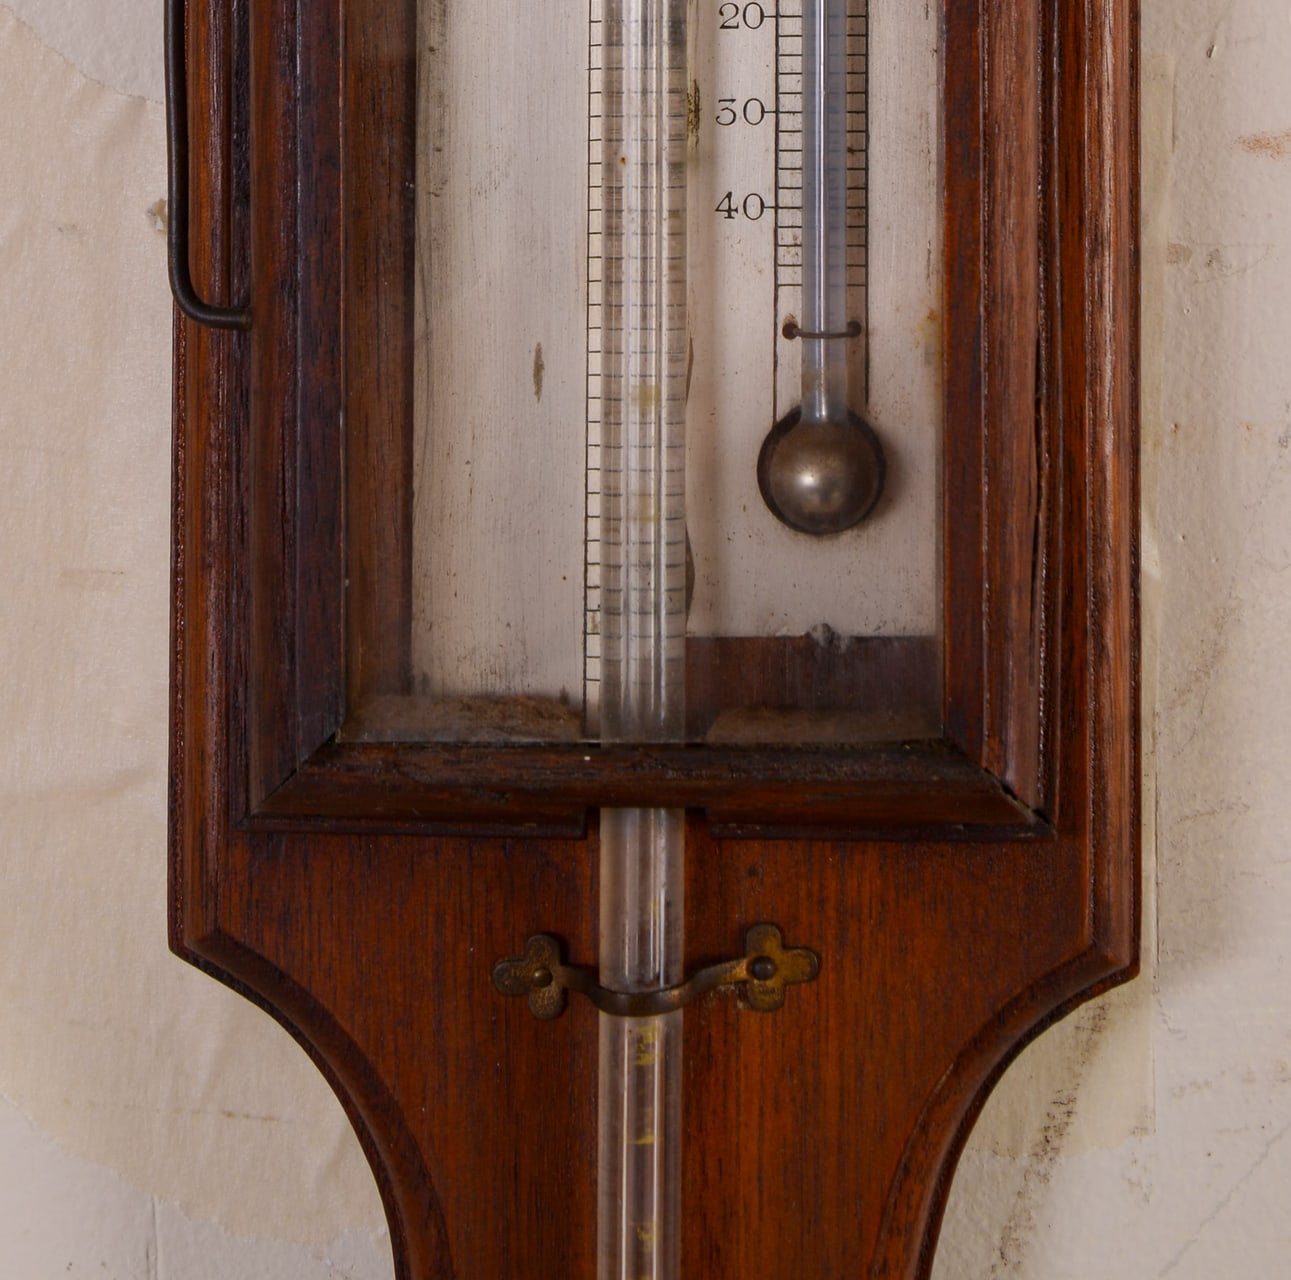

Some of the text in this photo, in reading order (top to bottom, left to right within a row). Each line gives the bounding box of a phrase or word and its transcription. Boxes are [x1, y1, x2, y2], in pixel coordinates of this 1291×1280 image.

[718, 2, 766, 29] 20
[715, 97, 766, 125] 30
[714, 192, 766, 221] 40
